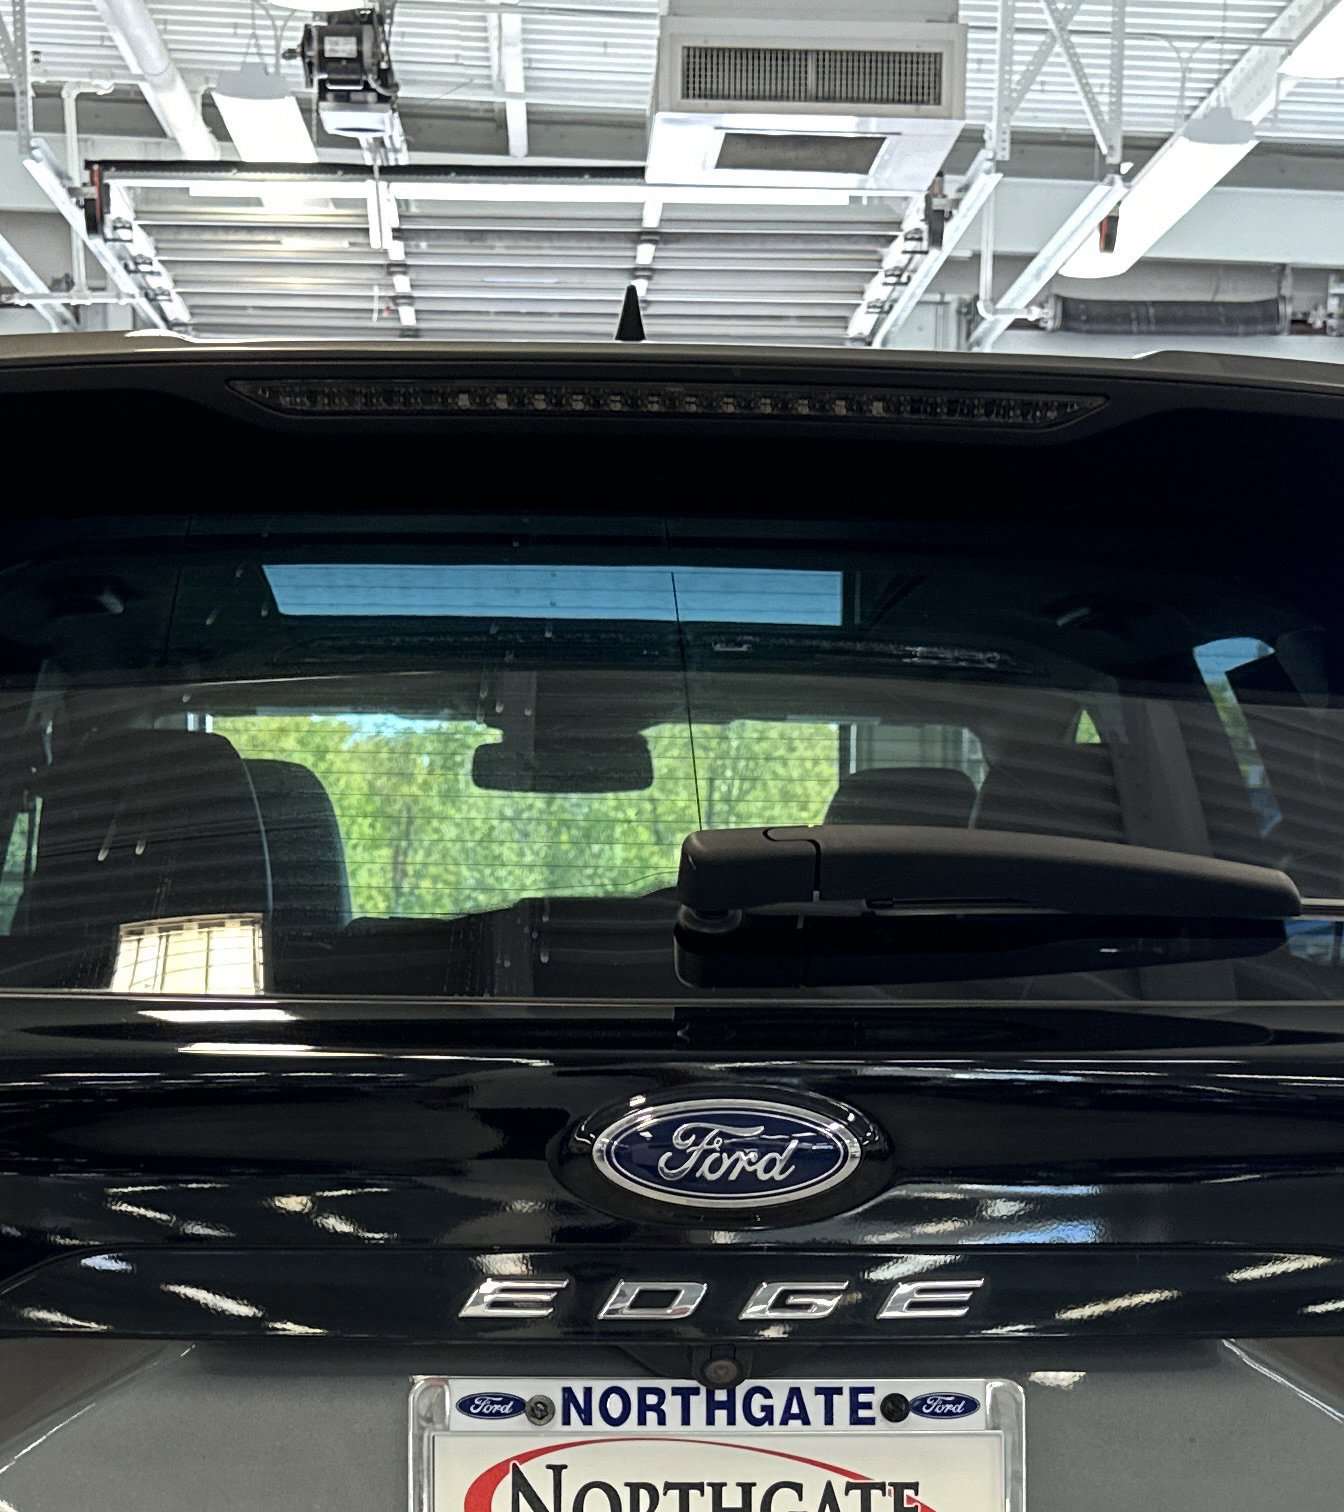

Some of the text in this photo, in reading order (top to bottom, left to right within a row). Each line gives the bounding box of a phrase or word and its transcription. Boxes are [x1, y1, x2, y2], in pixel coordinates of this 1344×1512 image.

[658, 1121, 799, 1182] Ford
[458, 1277, 985, 1320] EDGE
[469, 1385, 966, 1428] Ford NORTHGATE Ford
